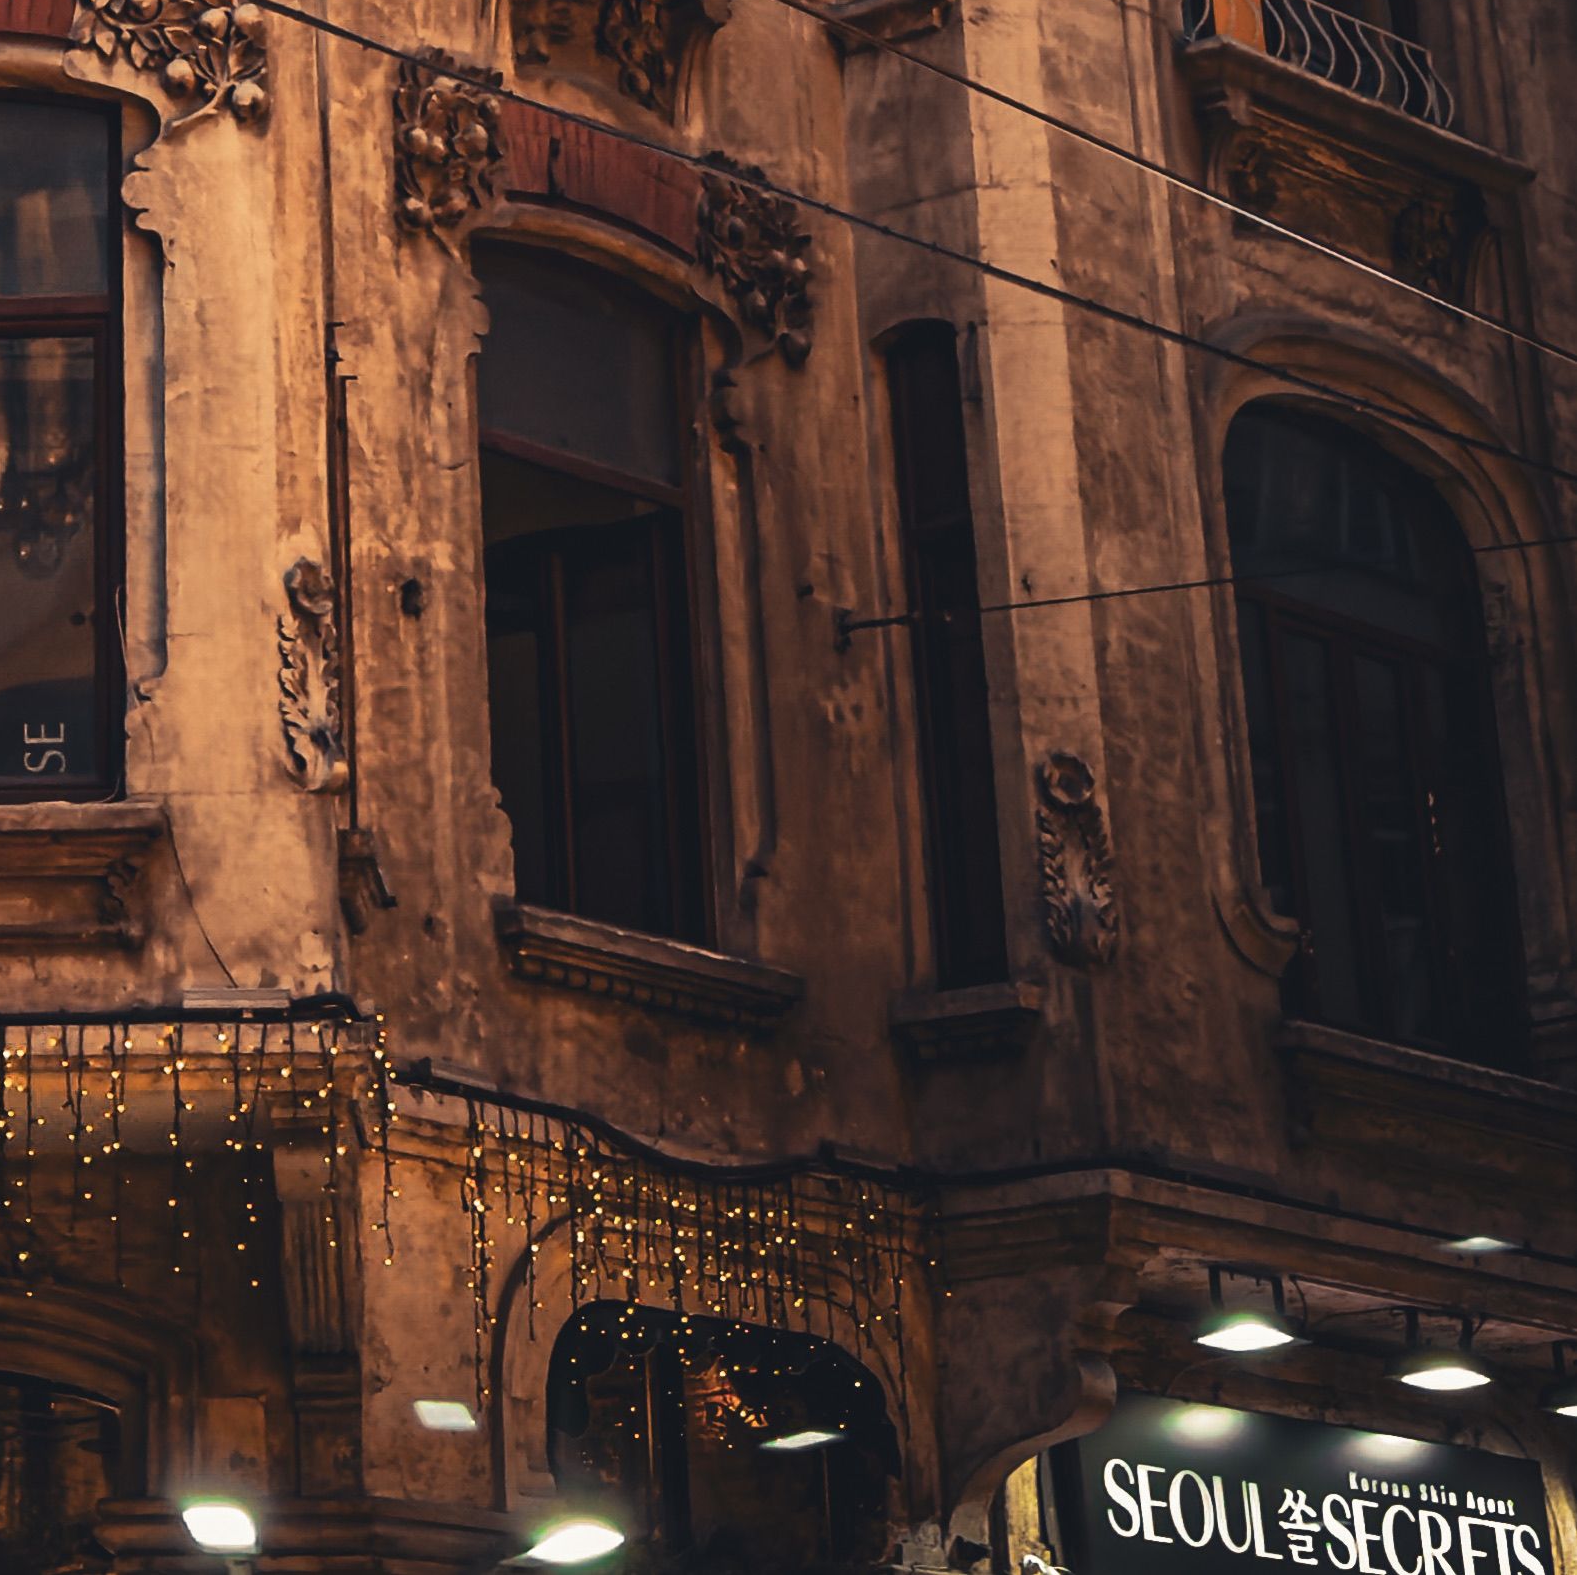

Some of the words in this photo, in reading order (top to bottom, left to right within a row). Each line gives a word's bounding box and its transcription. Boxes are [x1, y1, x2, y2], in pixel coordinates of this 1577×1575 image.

[1103, 1458, 1284, 1560] SEOUL
[1322, 1493, 1546, 1575] SECRETS
[1348, 1471, 1412, 1499] Korean
[1419, 1483, 1458, 1507] Skin
